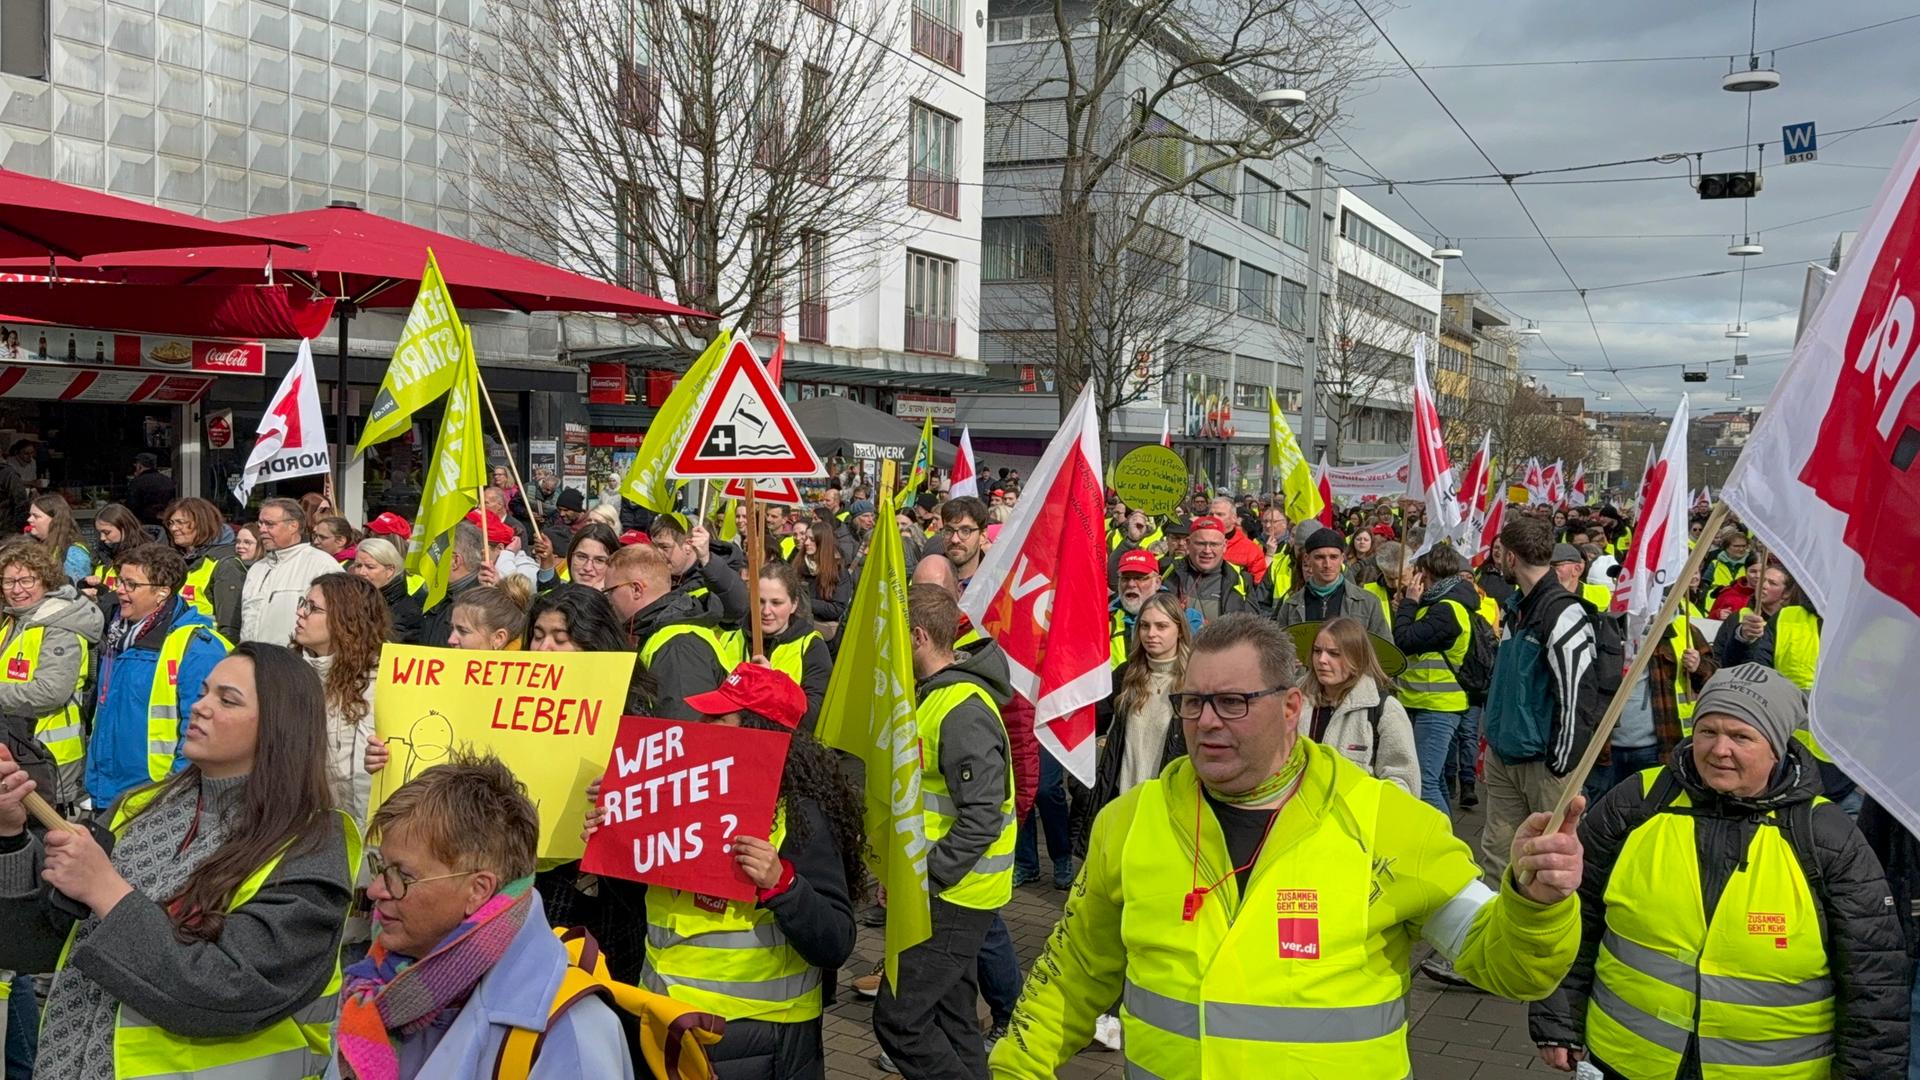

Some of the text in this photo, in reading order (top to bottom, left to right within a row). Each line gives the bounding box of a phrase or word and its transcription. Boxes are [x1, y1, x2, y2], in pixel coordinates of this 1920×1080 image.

[1785, 125, 1813, 150] W
[1789, 152, 1814, 163] 810
[853, 443, 906, 460] backWERK
[391, 656, 565, 690] WIR RETTEN
[1729, 683, 1769, 708] WETTER
[490, 696, 602, 736] LEBEN
[615, 725, 685, 779] WER
[603, 755, 735, 827] RETTET
[633, 813, 738, 874] UNS ?
[696, 893, 726, 910] ver.di
[1276, 891, 1318, 901] ZUSAMMEN
[1276, 901, 1318, 911] GEHT MEHR
[1747, 914, 1786, 924] ZUSAMMEN
[1747, 924, 1786, 932] GEHT MEHR
[1281, 940, 1317, 955] ver.di
